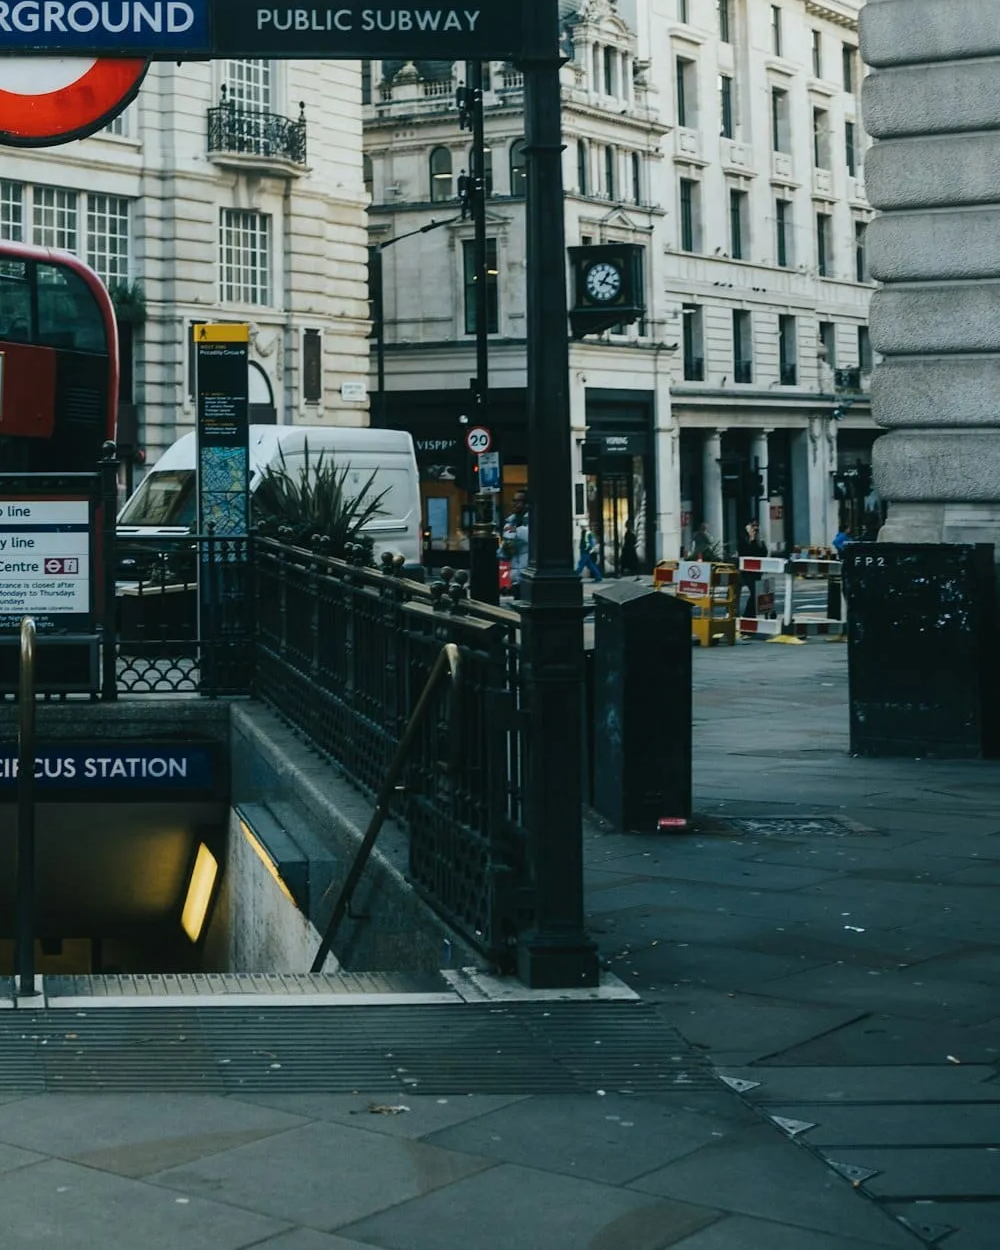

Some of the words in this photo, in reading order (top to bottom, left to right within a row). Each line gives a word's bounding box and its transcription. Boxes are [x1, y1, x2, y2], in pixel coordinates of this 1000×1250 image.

[257, 9, 353, 30] PUBLIC
[361, 9, 481, 31] SUBWAY
[417, 440, 456, 450] VISPRI
[470, 435, 488, 447] 20
[8, 506, 31, 517] line
[11, 537, 35, 548] line
[40, 590, 75, 598] Thursdays
[84, 757, 187, 777] STATION
